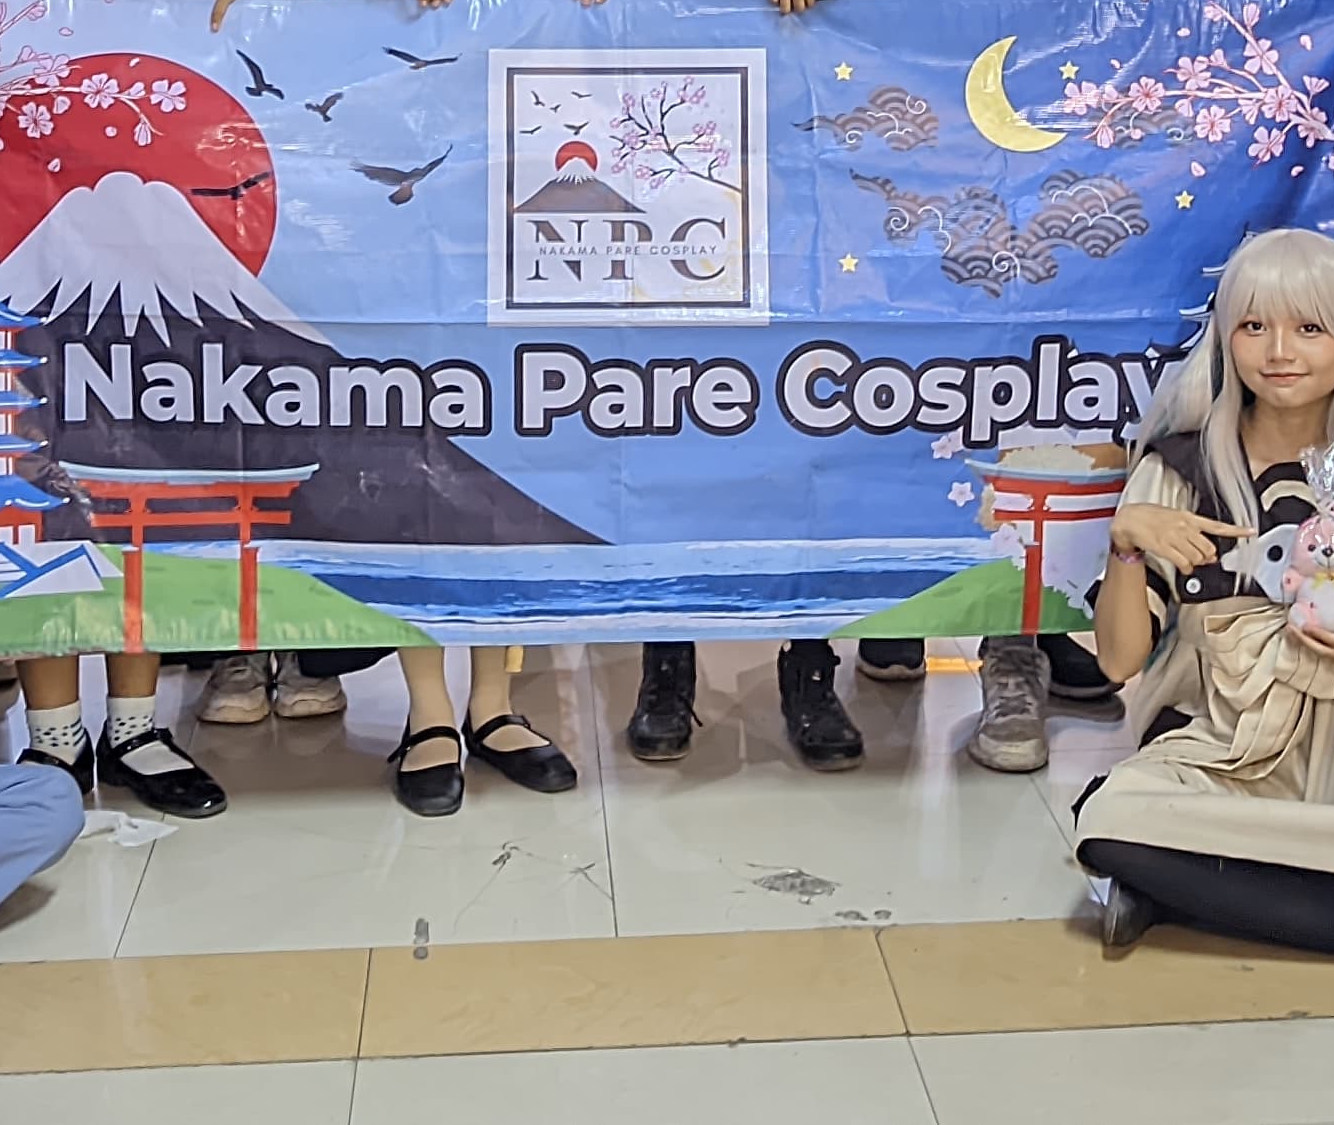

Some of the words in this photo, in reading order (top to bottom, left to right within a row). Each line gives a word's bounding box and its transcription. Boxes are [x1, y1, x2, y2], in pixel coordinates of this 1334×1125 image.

[526, 218, 726, 281] NPC
[539, 246, 598, 256] NAKAMA
[606, 246, 641, 256] PARE
[649, 245, 717, 255] COSPLAY
[63, 343, 484, 428] Nakama
[522, 351, 752, 428] Pare
